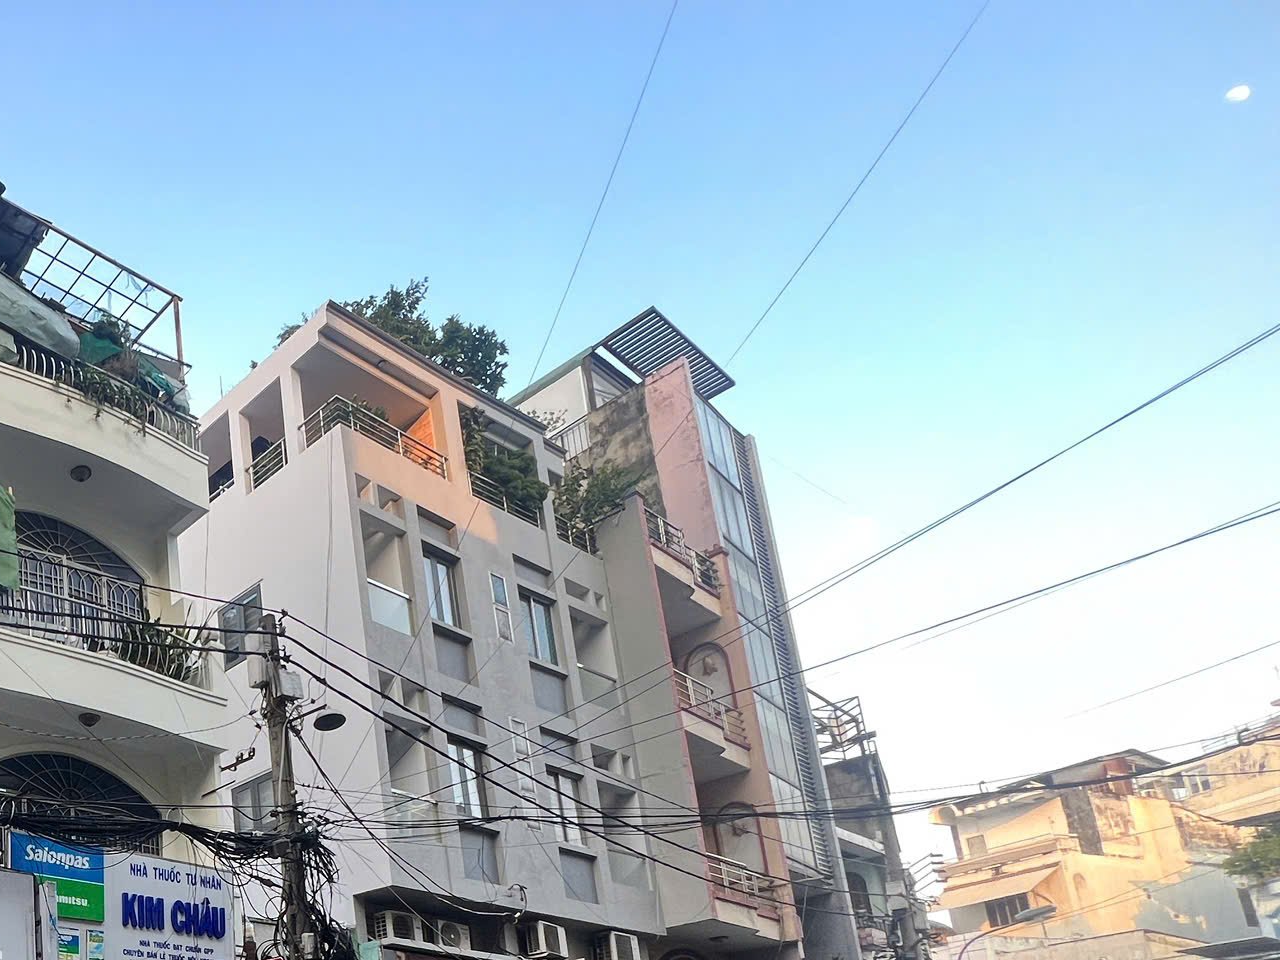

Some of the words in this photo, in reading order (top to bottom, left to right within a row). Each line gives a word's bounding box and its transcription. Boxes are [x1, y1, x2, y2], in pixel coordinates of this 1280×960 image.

[25, 844, 90, 869] Salonpas
[130, 862, 148, 878] NHÀ
[153, 866, 181, 883] THUỐC
[200, 875, 222, 890] NHÂN
[122, 892, 165, 931] KIM
[171, 897, 225, 940] CHÂU
[123, 949, 144, 958] CHUYÊN
